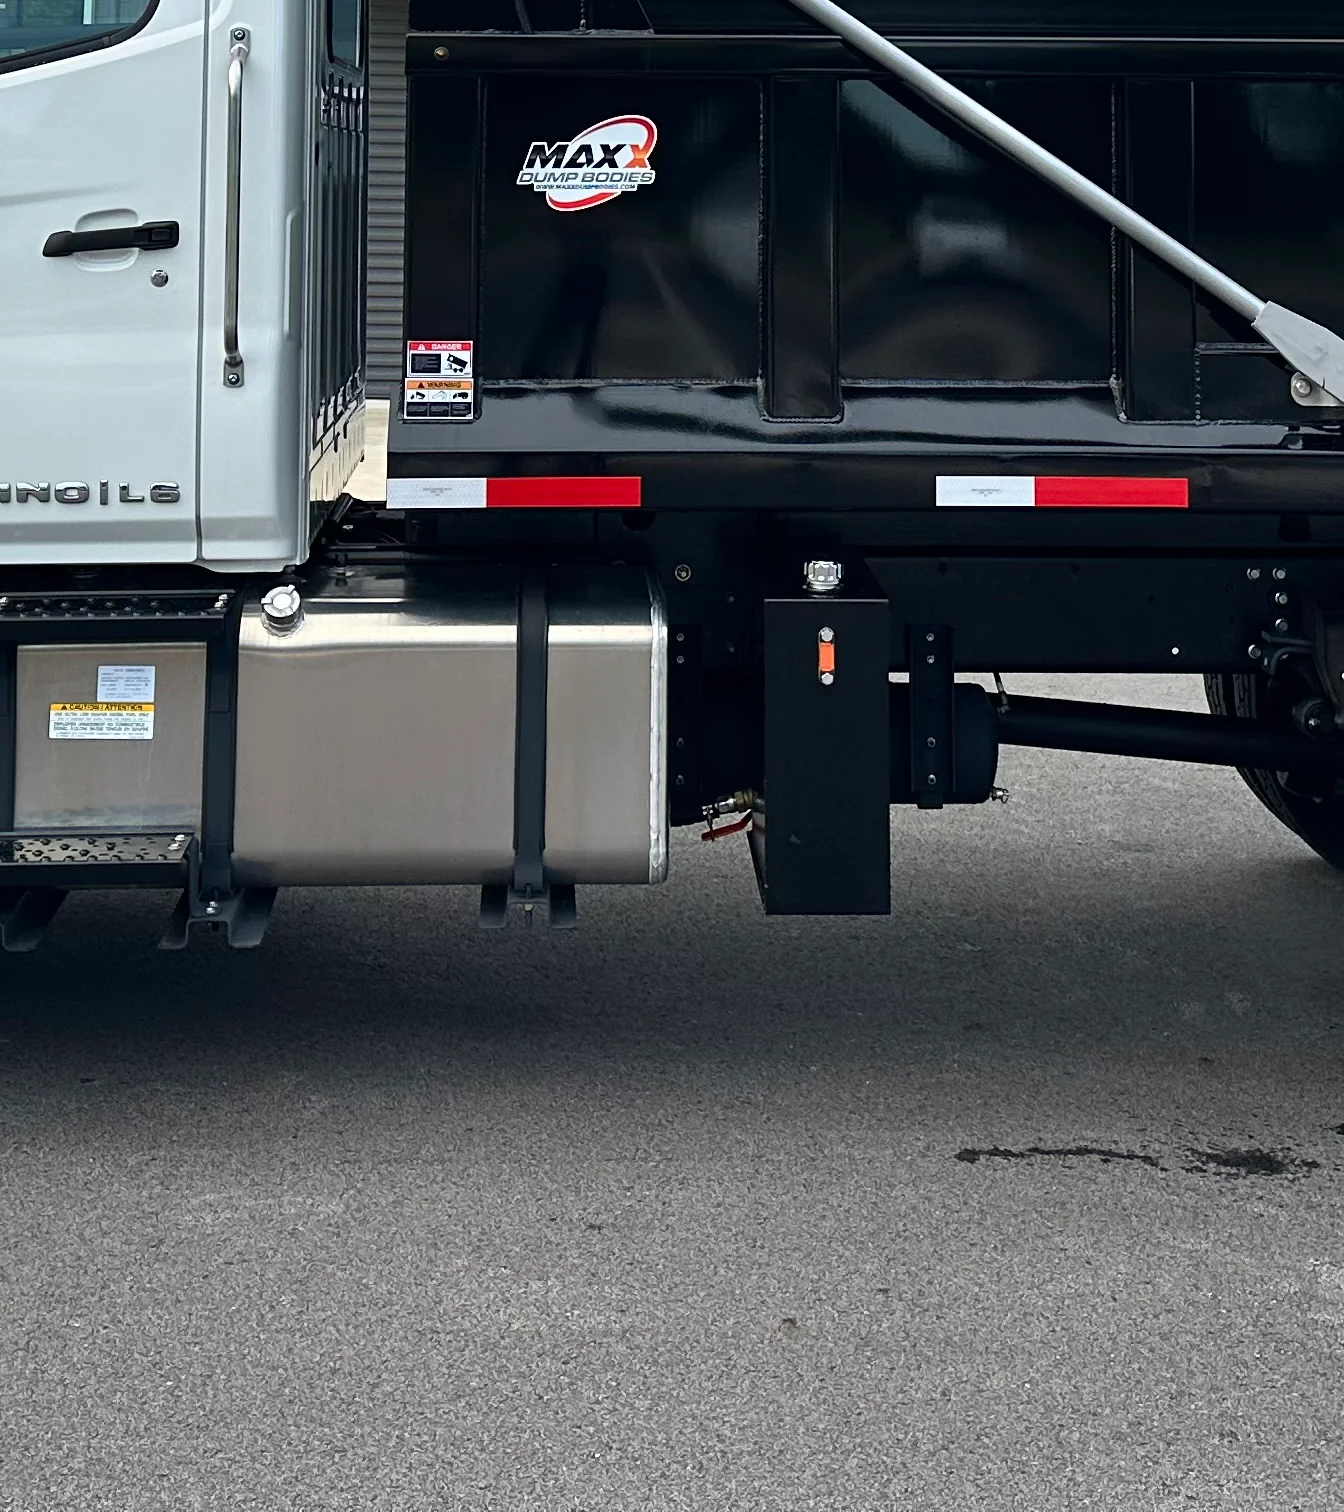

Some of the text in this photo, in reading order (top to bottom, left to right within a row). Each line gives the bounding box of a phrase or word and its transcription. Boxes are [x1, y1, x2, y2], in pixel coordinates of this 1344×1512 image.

[525, 143, 648, 169] MAXX
[518, 172, 654, 183] DUMP BODIES
